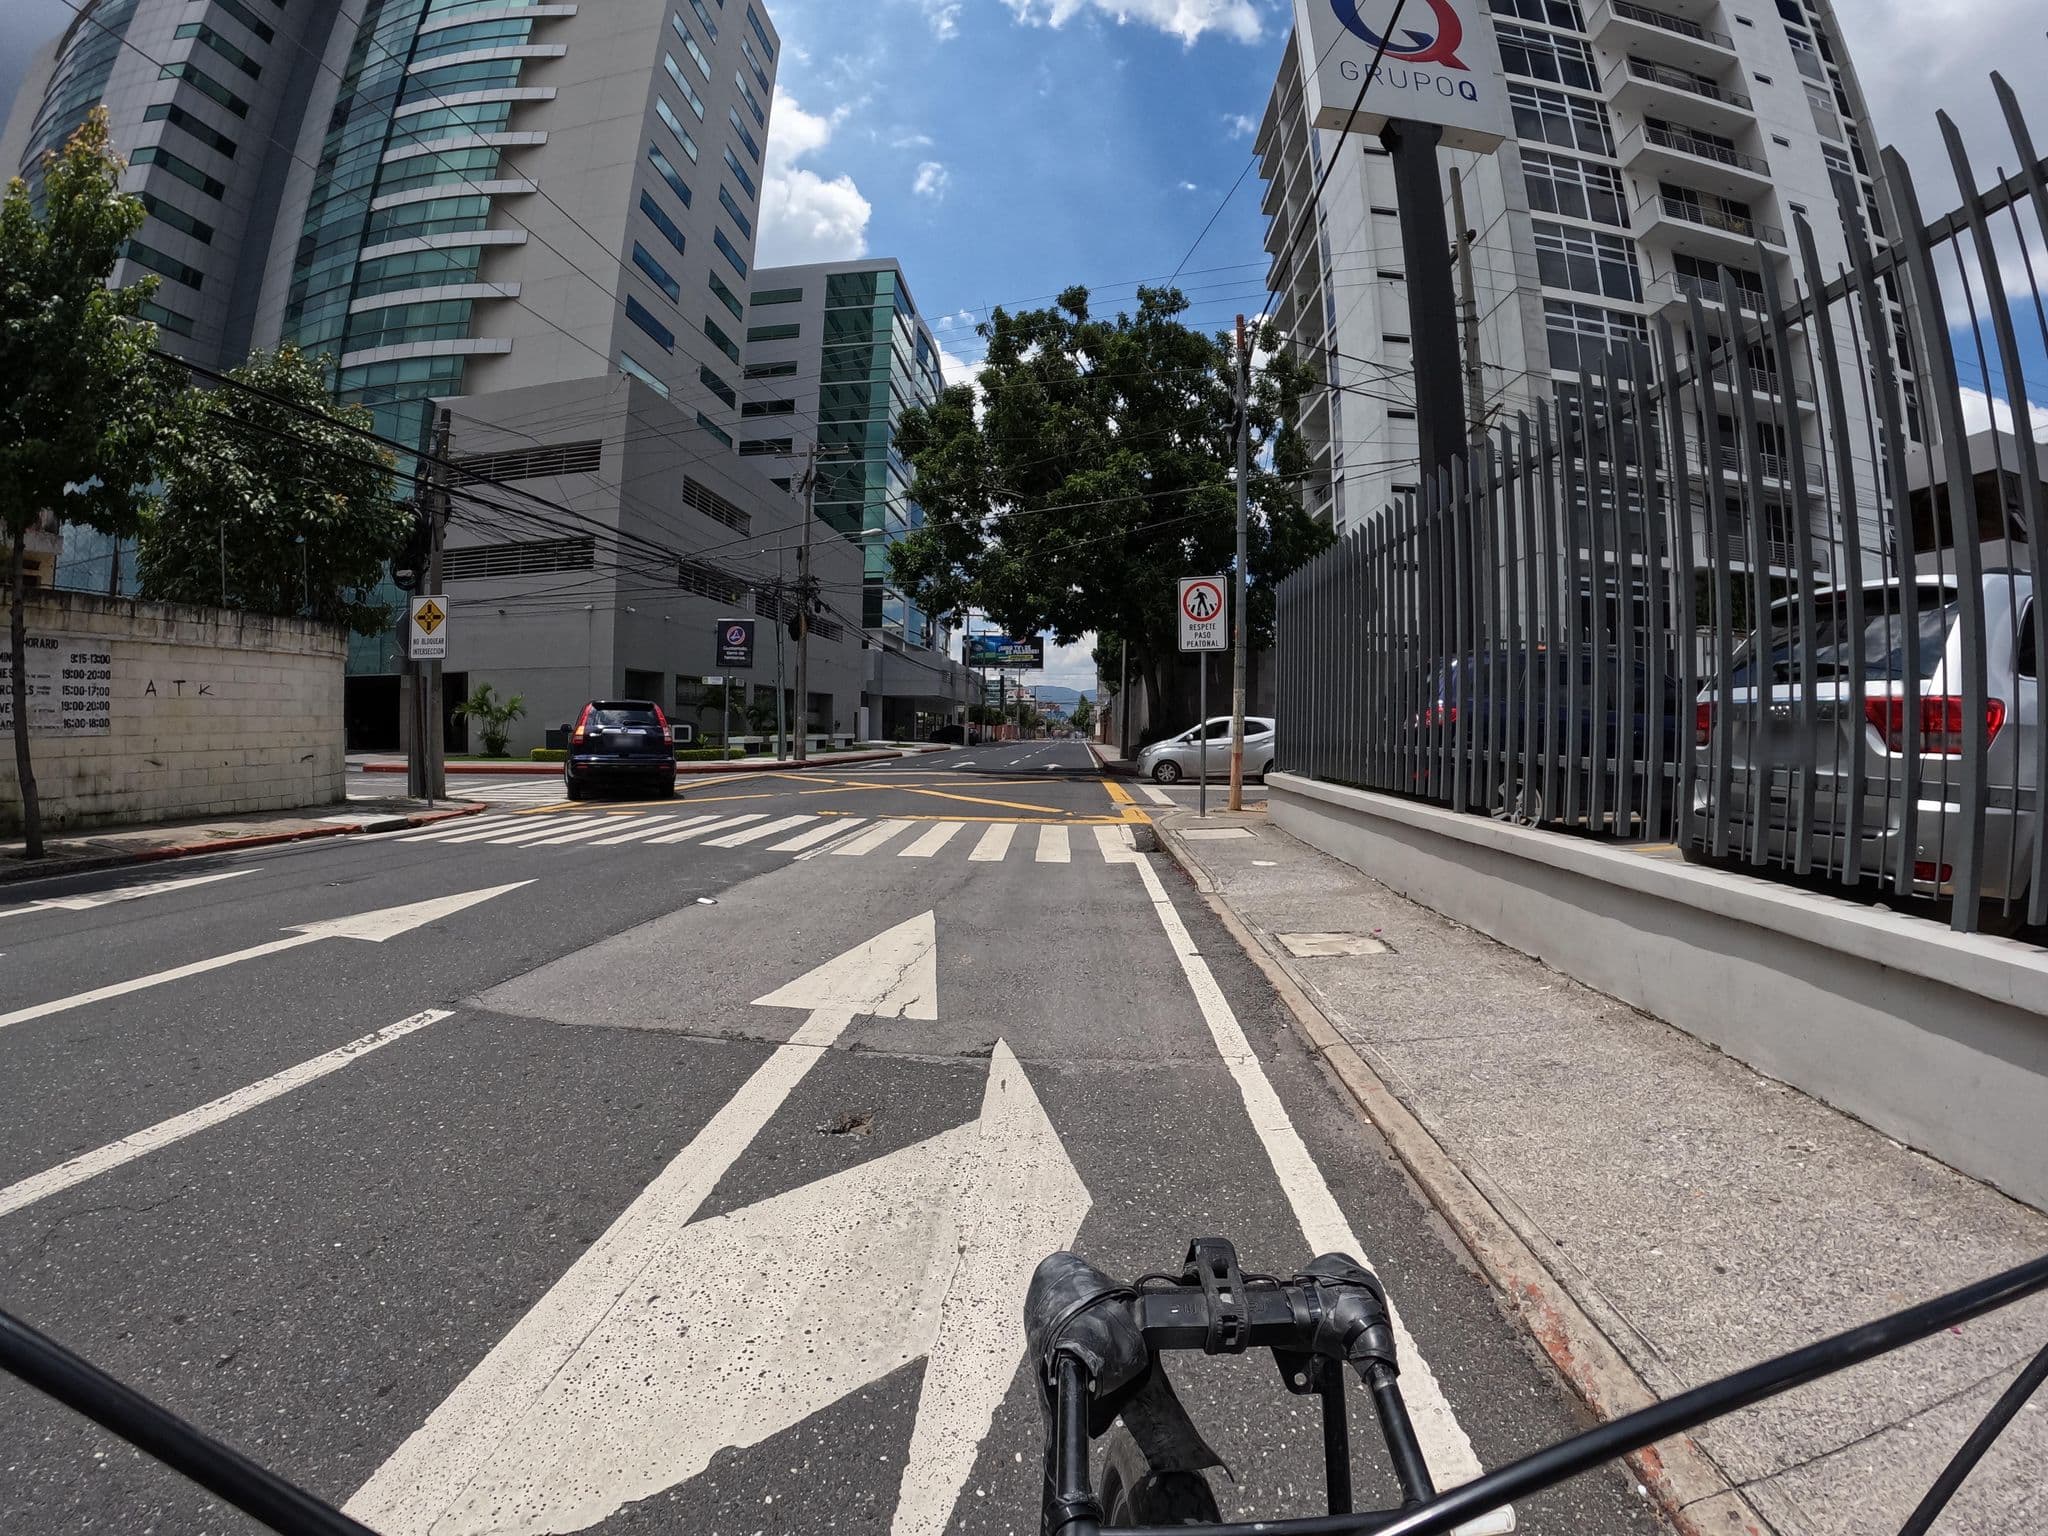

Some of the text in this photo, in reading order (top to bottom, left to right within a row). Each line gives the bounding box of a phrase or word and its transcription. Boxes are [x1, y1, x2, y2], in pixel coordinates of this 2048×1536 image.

[1189, 623, 1216, 631] RESPETE
[1194, 631, 1211, 639] PASO
[1186, 640, 1220, 648] PEATONAL
